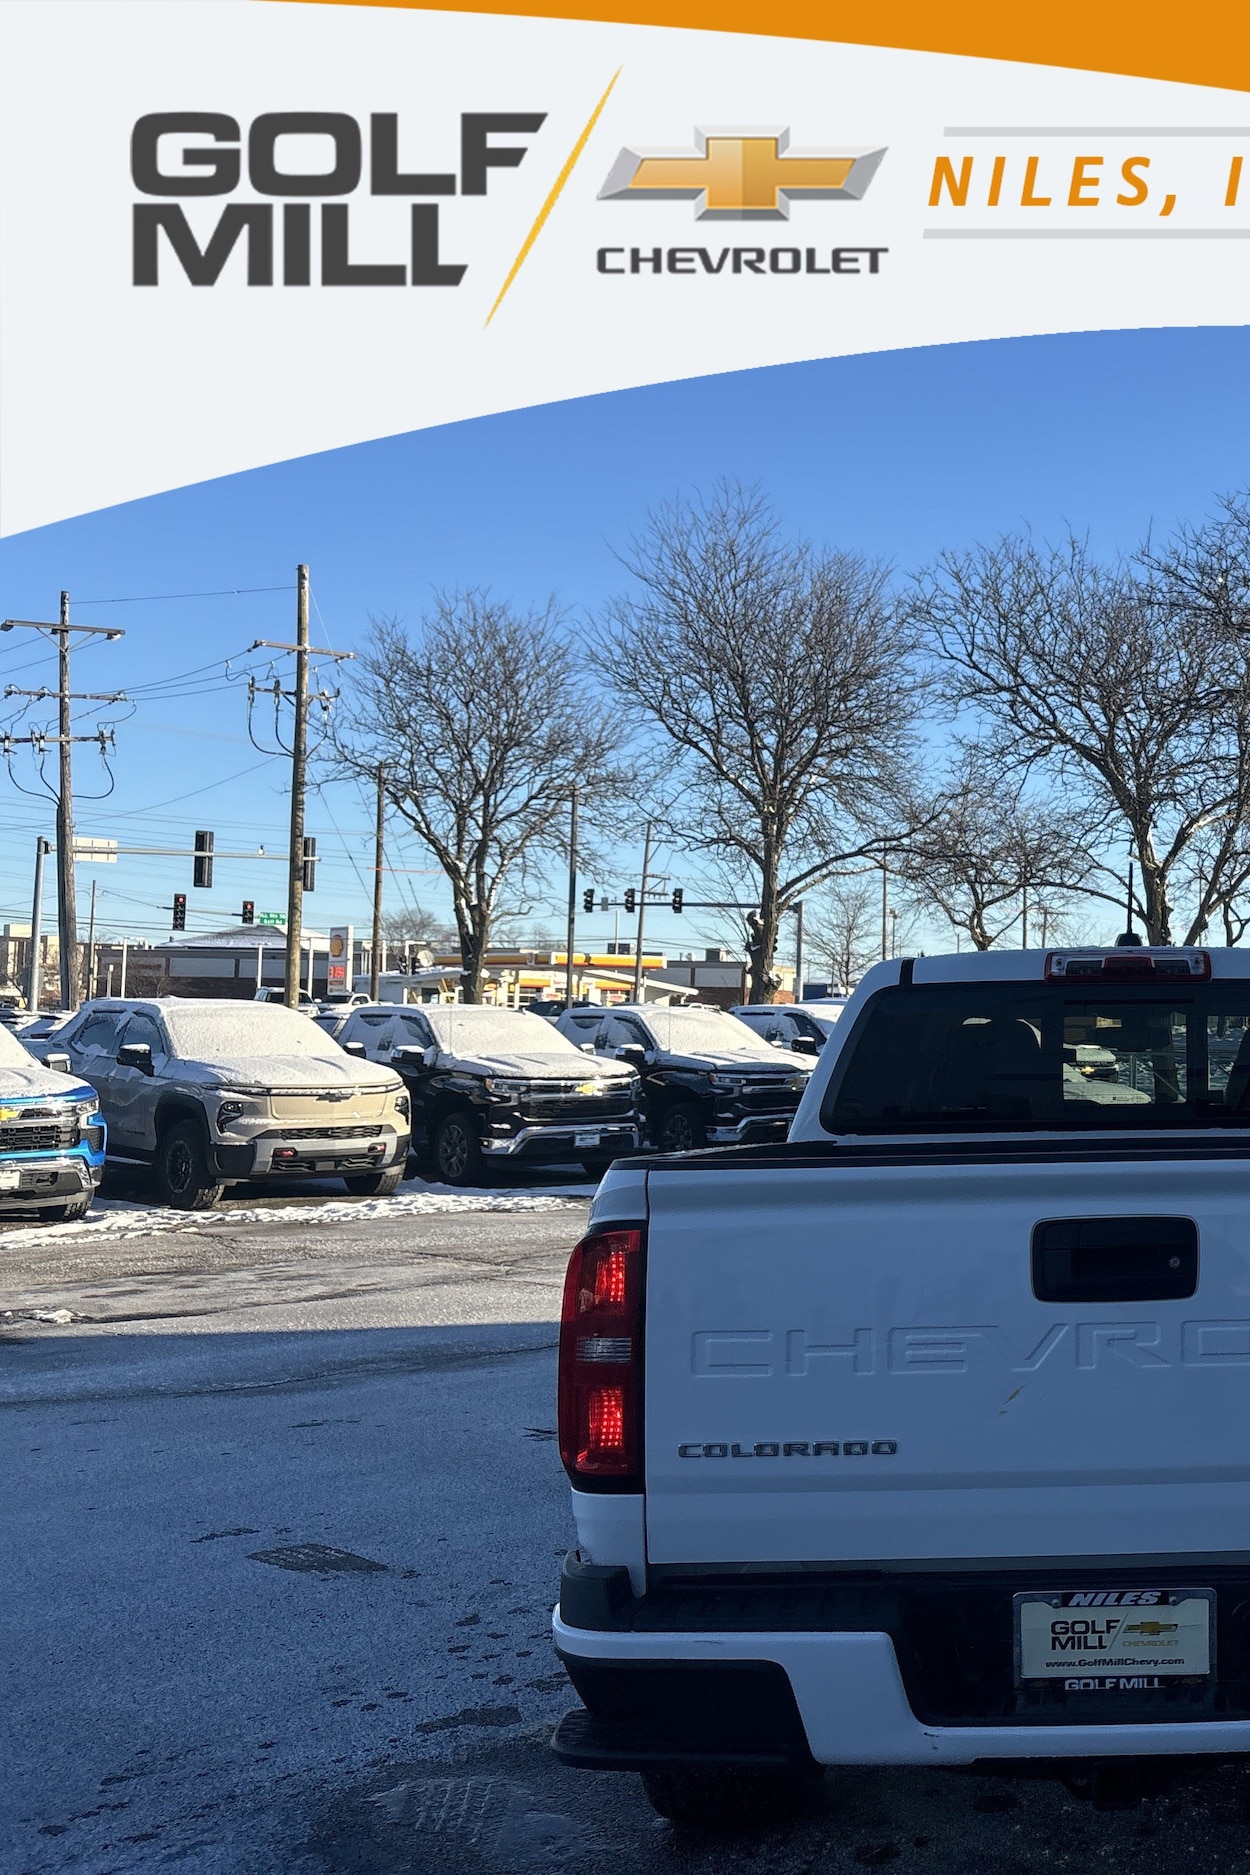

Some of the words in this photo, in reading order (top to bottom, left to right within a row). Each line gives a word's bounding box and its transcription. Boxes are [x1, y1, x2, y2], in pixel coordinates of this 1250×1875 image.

[677, 1439, 898, 1458] COLORADO
[1068, 1591, 1162, 1606] NILES
[1050, 1619, 1121, 1635] GOLF
[1051, 1635, 1108, 1650] MILL
[1122, 1639, 1179, 1647] CHEVROLET
[1045, 1657, 1185, 1668] www.GolfMillChevy.com
[1064, 1678, 1118, 1691] GOLF
[1119, 1677, 1166, 1690] MILL
